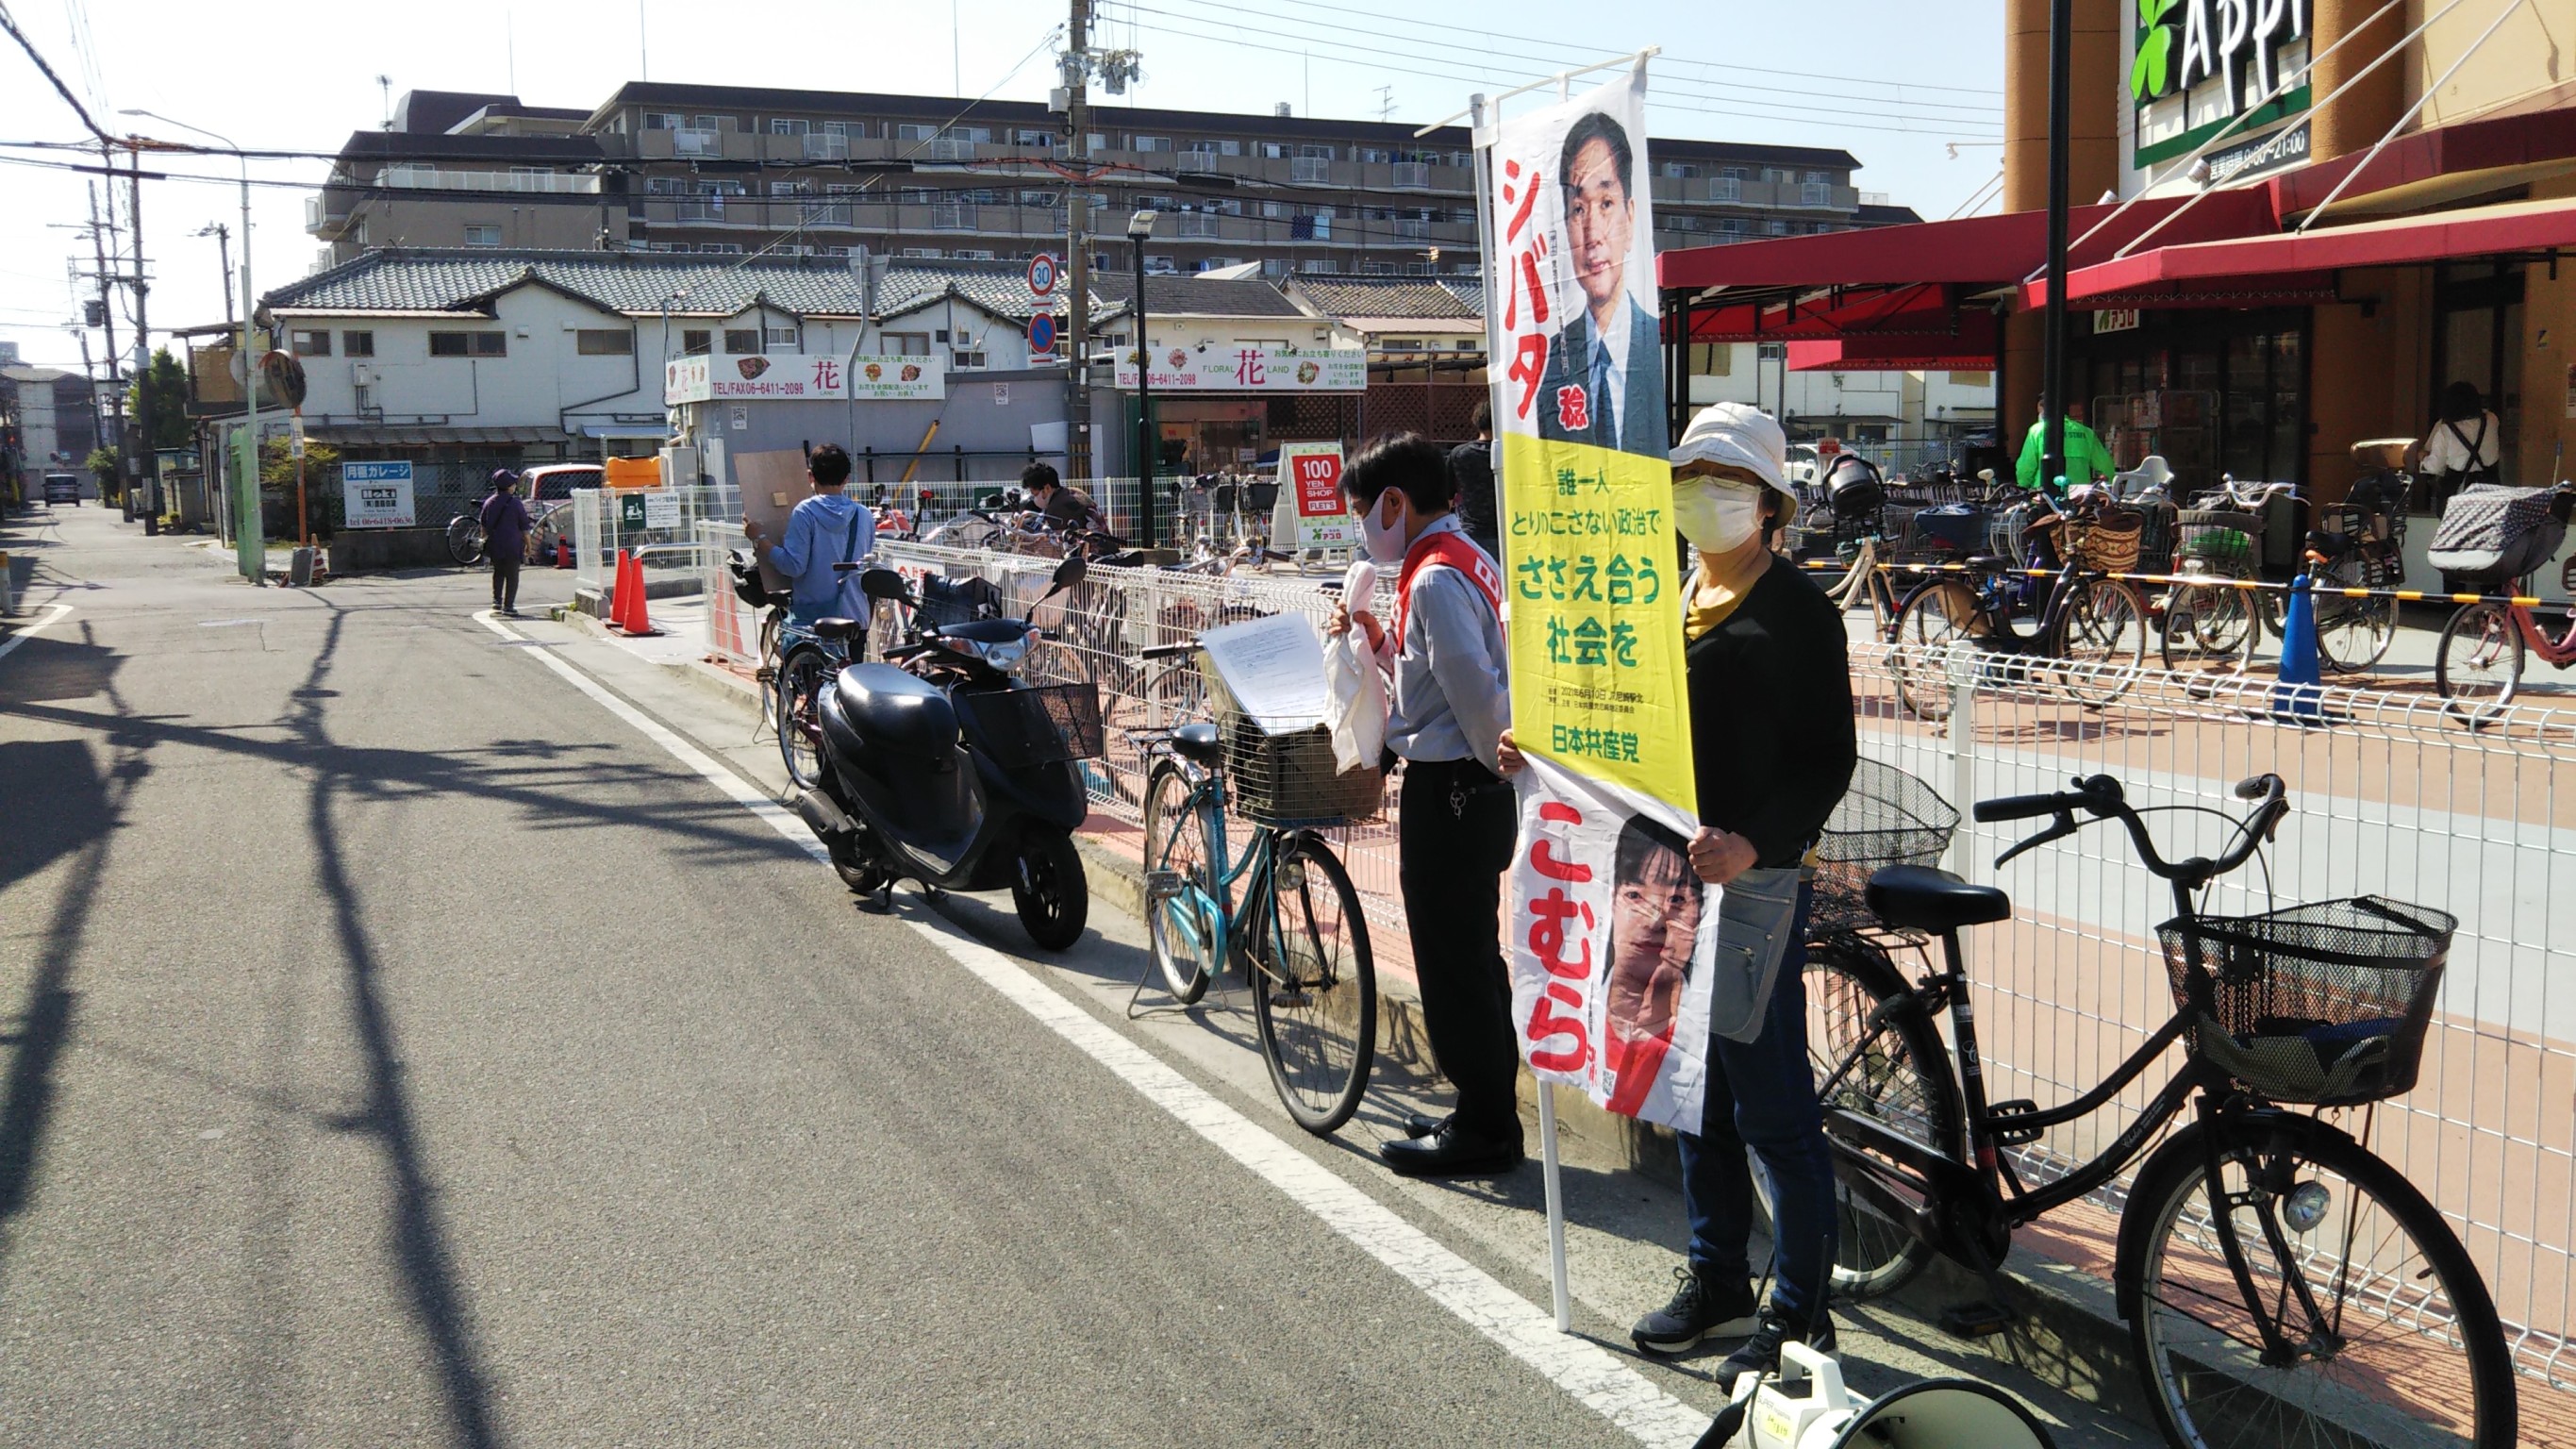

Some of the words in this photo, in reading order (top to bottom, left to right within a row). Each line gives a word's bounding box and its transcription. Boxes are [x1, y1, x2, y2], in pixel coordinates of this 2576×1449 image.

[2180, 0, 2302, 117] APP
[1034, 267, 1050, 285] 30
[1504, 158, 1549, 420] シバタ
[811, 360, 840, 391] 花
[1203, 365, 1236, 374] FLORAL
[1233, 349, 1266, 386] 花
[1267, 365, 1289, 374] LAND
[1559, 385, 1589, 430] 稔
[346, 465, 409, 479] 月極ガレージ
[1302, 459, 1333, 479] 100
[1557, 467, 1610, 496] 誰一人
[1517, 553, 1660, 605] ささえ合う
[1546, 615, 1638, 668] 社会を
[1553, 724, 1640, 763] 日本共産党
[1526, 801, 1593, 1074] こむら
